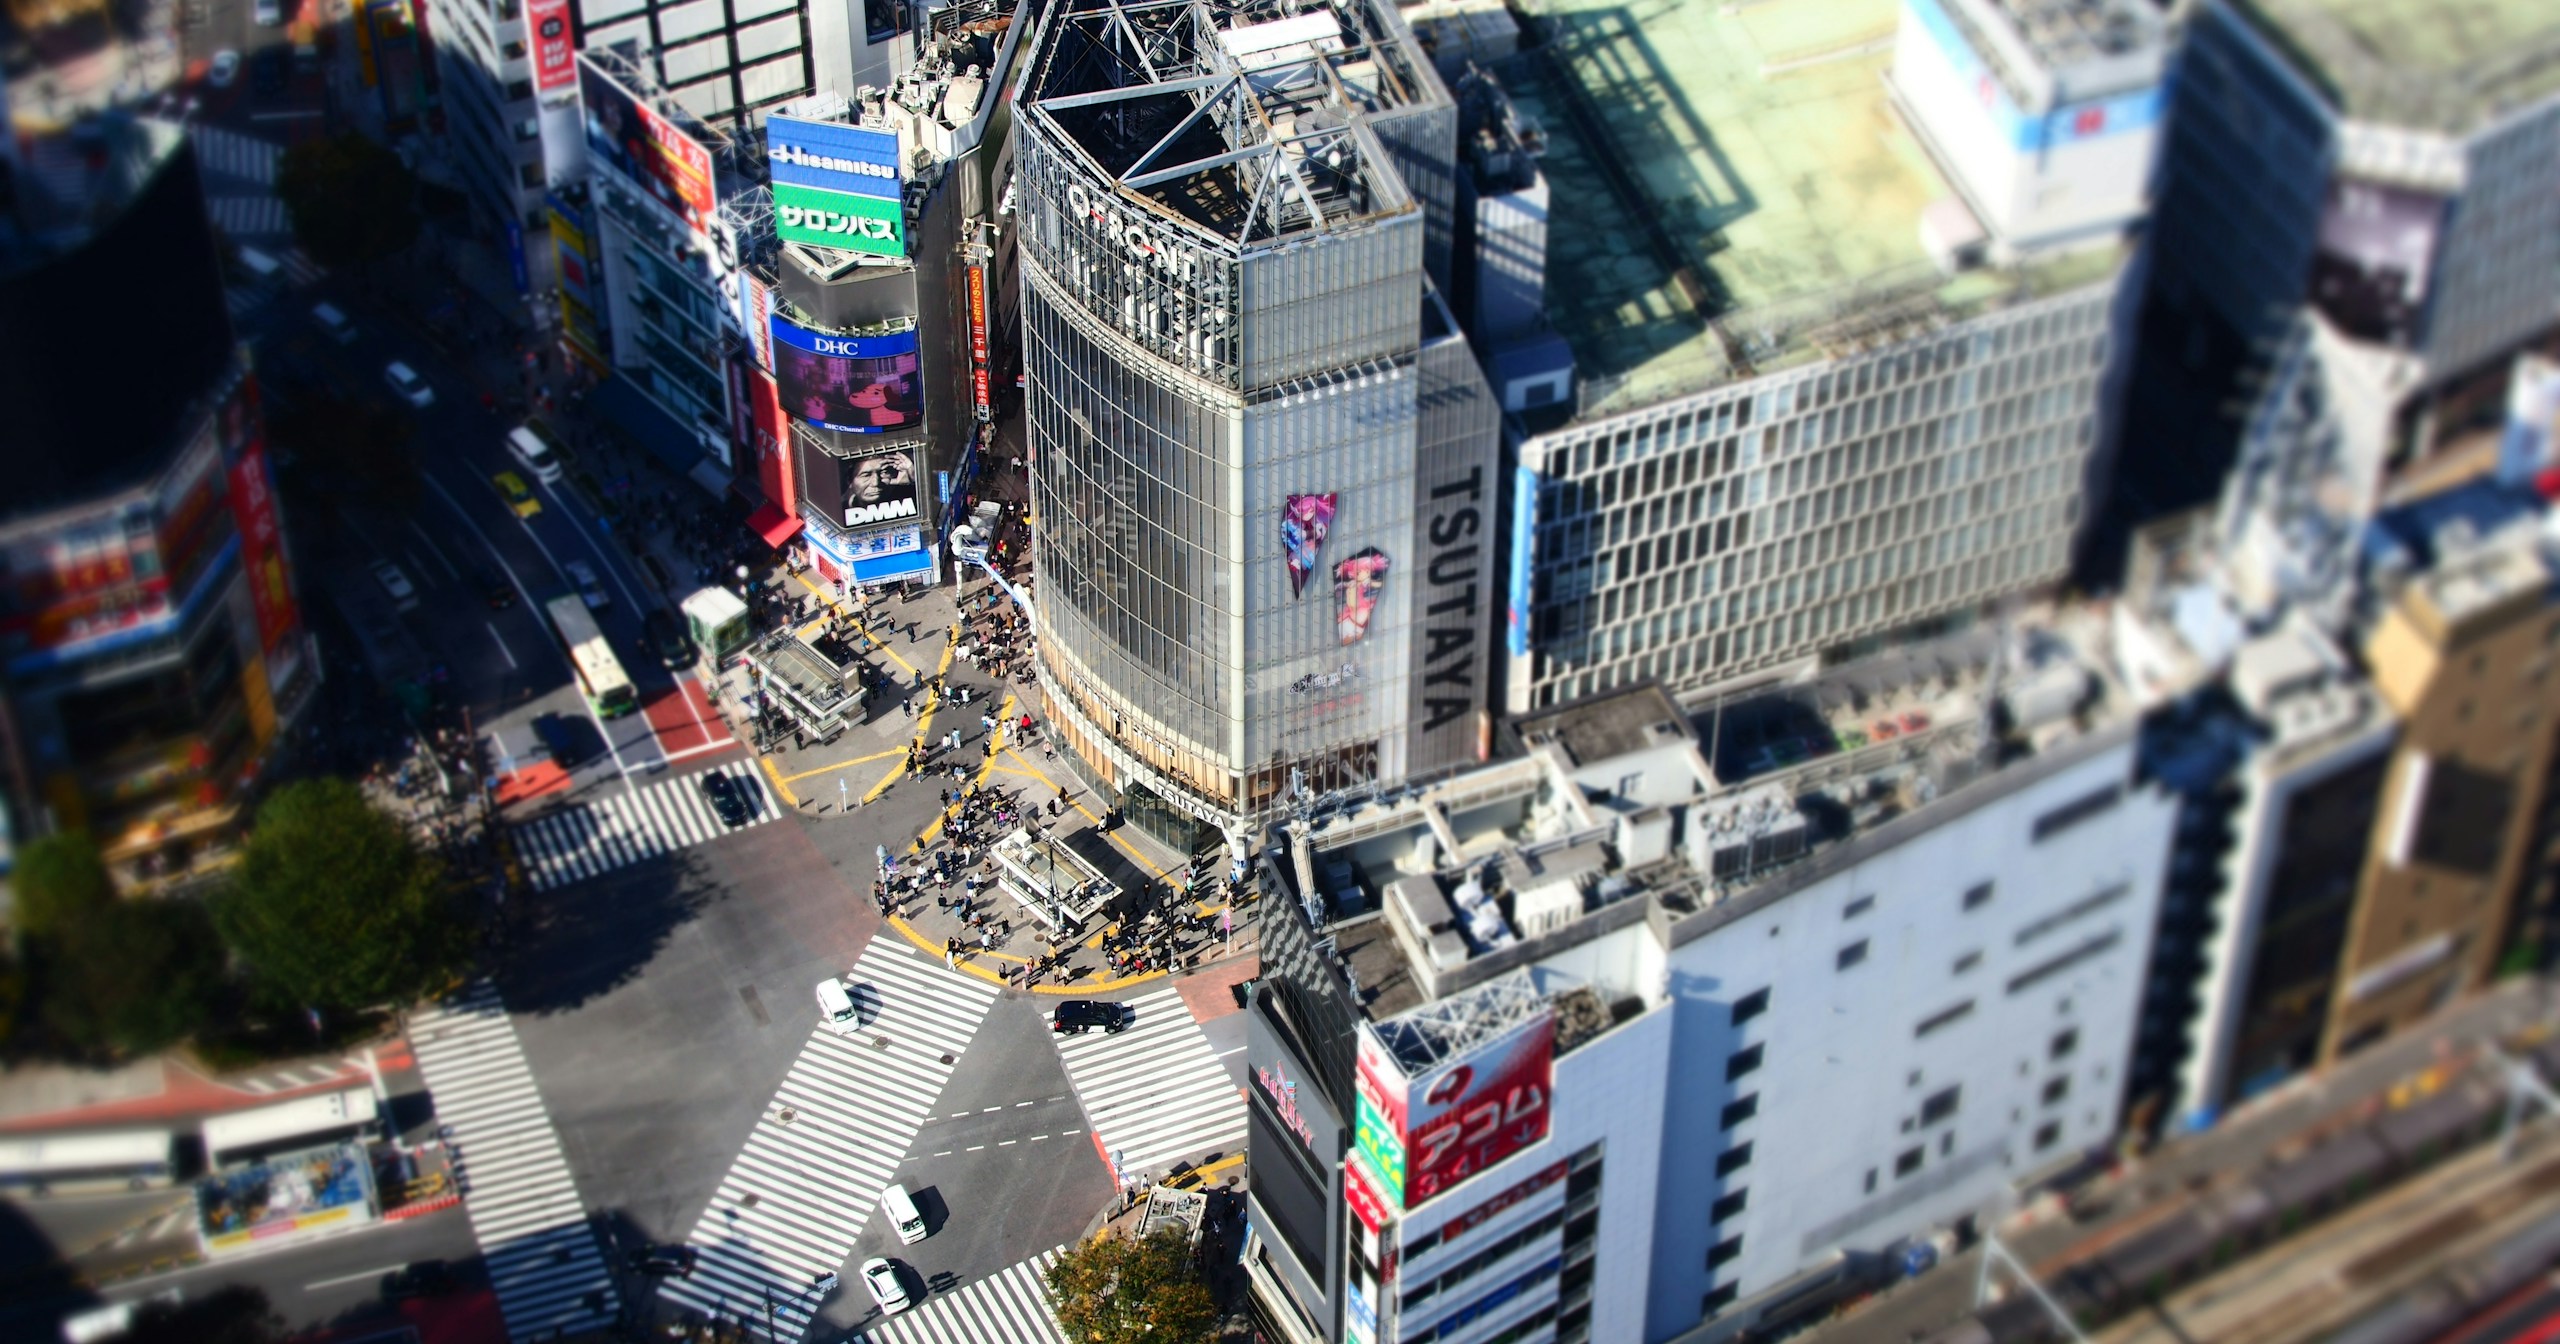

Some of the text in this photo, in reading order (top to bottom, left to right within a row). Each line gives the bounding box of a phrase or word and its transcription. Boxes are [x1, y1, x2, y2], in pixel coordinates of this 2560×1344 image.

[768, 143, 896, 180] Hisamitsu
[780, 203, 897, 242] サロンパス
[814, 337, 859, 356] DHC
[824, 422, 865, 434] DHC Channel
[845, 498, 917, 526] DMM
[1423, 464, 1482, 734] TSUTAYA
[1155, 783, 1225, 829] TSUTAYA
[1360, 1102, 1402, 1164] レイク
[1418, 1083, 1543, 1168] アコム
[1358, 1126, 1403, 1188] ALSA
